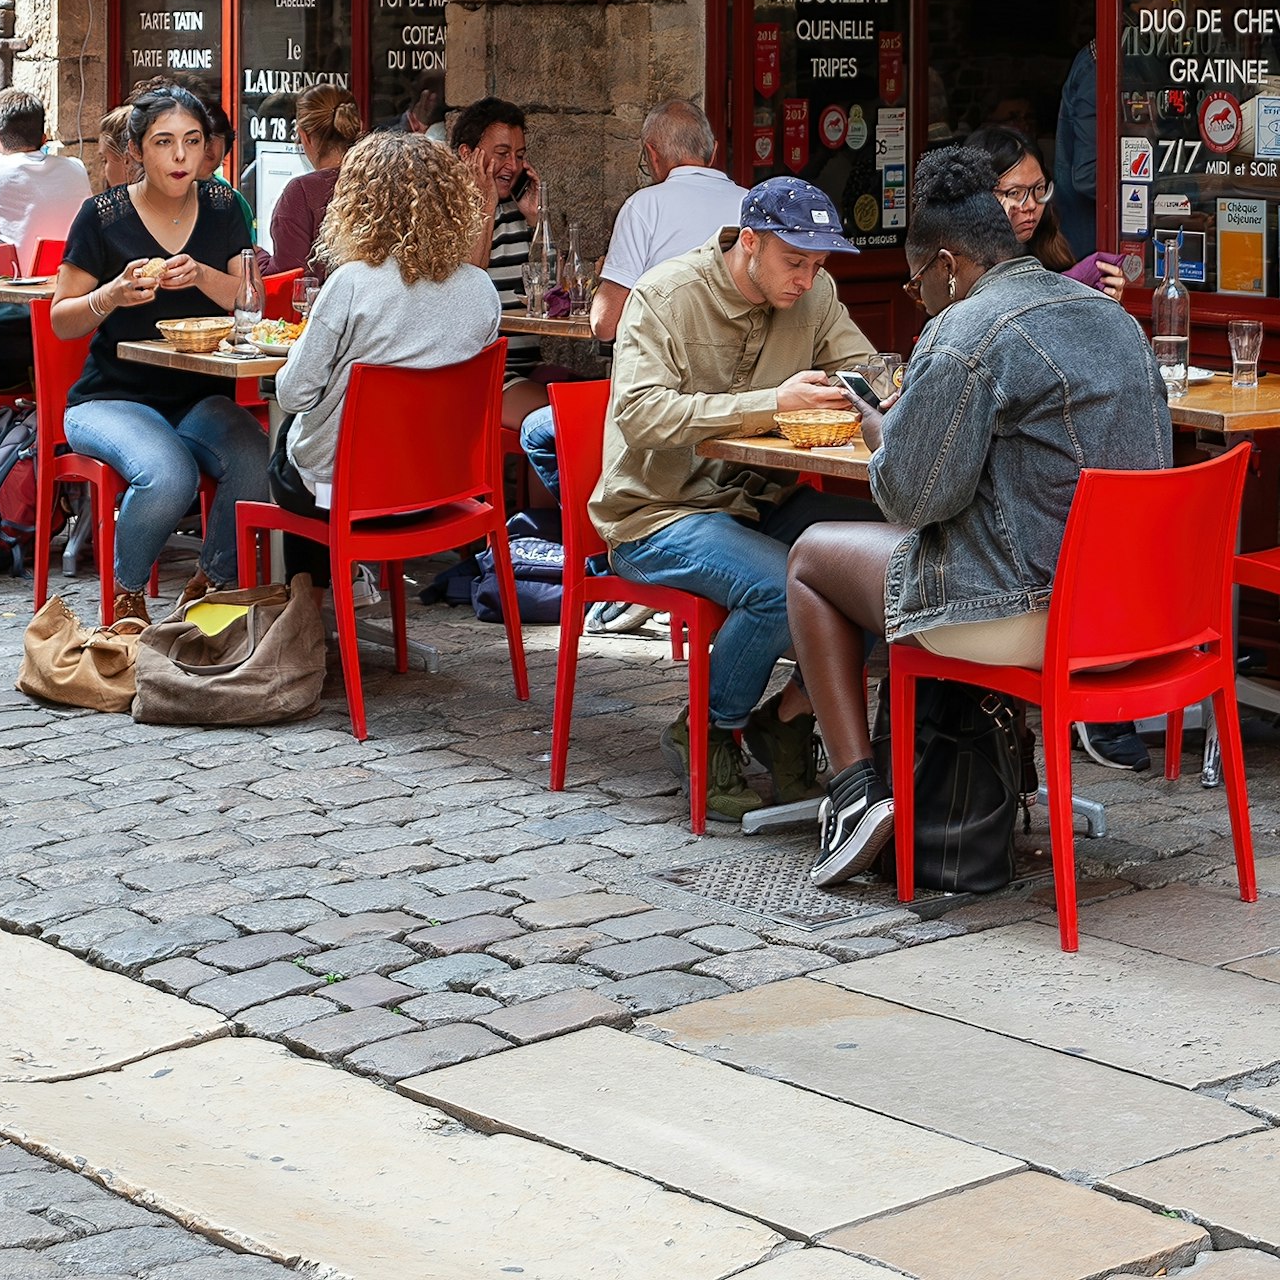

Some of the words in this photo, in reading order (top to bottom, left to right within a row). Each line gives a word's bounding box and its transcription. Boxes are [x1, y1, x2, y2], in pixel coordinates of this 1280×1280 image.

[140, 12, 170, 30] TARTE
[173, 11, 203, 30] TATIN
[796, 20, 874, 40] QUENELLE
[1140, 9, 1186, 33] DUO
[1196, 9, 1222, 33] DE
[132, 49, 162, 67] TARTE
[167, 49, 212, 68] PRALINE
[287, 38, 302, 60] le
[388, 50, 406, 70] DU
[811, 57, 857, 78] TRIPES
[1170, 58, 1269, 84] GRATINEE
[244, 69, 349, 94] LAURENCIN
[250, 116, 266, 139] 04
[270, 117, 286, 140] 78
[1158, 139, 1202, 174] 7/7
[1205, 161, 1230, 175] MIDI
[1234, 162, 1246, 175] et
[1250, 161, 1277, 177] SOIR
[1227, 202, 1258, 214] Chèque
[1227, 214, 1263, 225] Déjeuner
